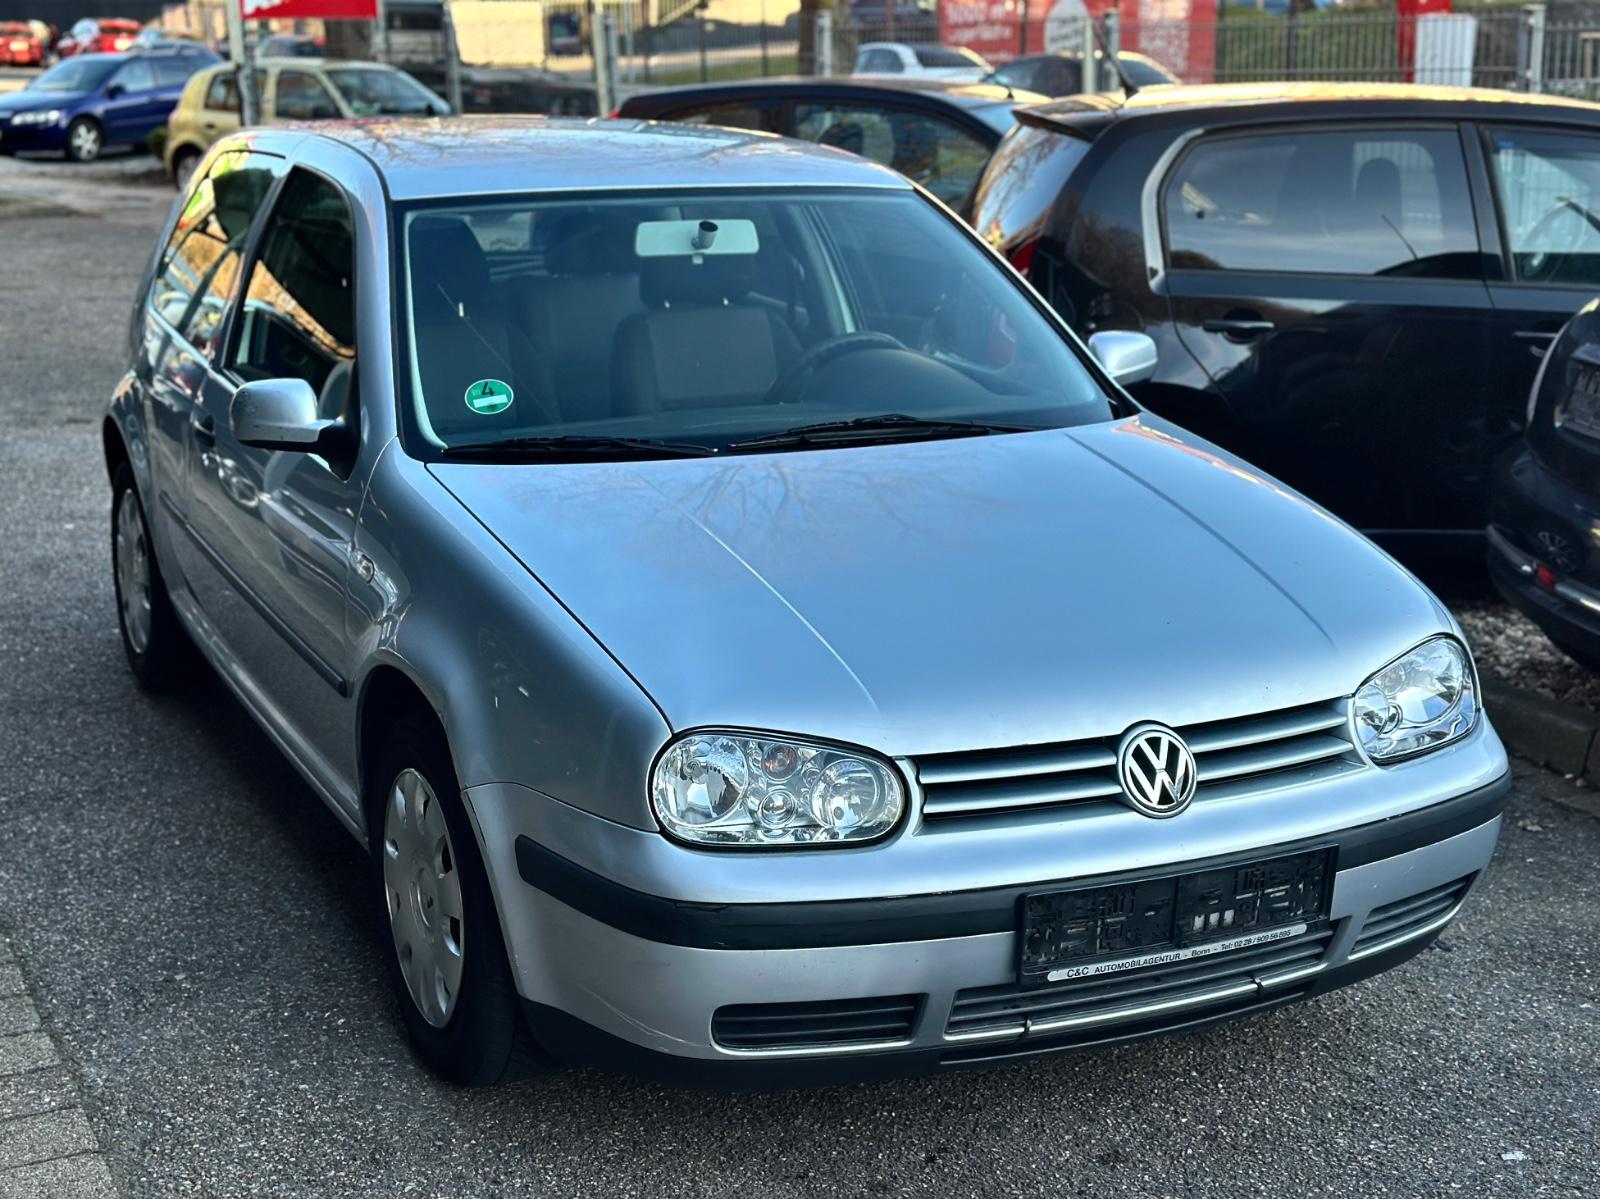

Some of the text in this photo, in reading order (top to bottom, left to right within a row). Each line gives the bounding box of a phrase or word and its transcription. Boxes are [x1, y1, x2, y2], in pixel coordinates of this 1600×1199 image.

[481, 381, 495, 396] 4
[1121, 724, 1195, 814] VW
[1066, 966, 1089, 978] C&C
[1093, 952, 1181, 974] AUTOMOBILAGENTUR
[1191, 948, 1211, 957] Bonn
